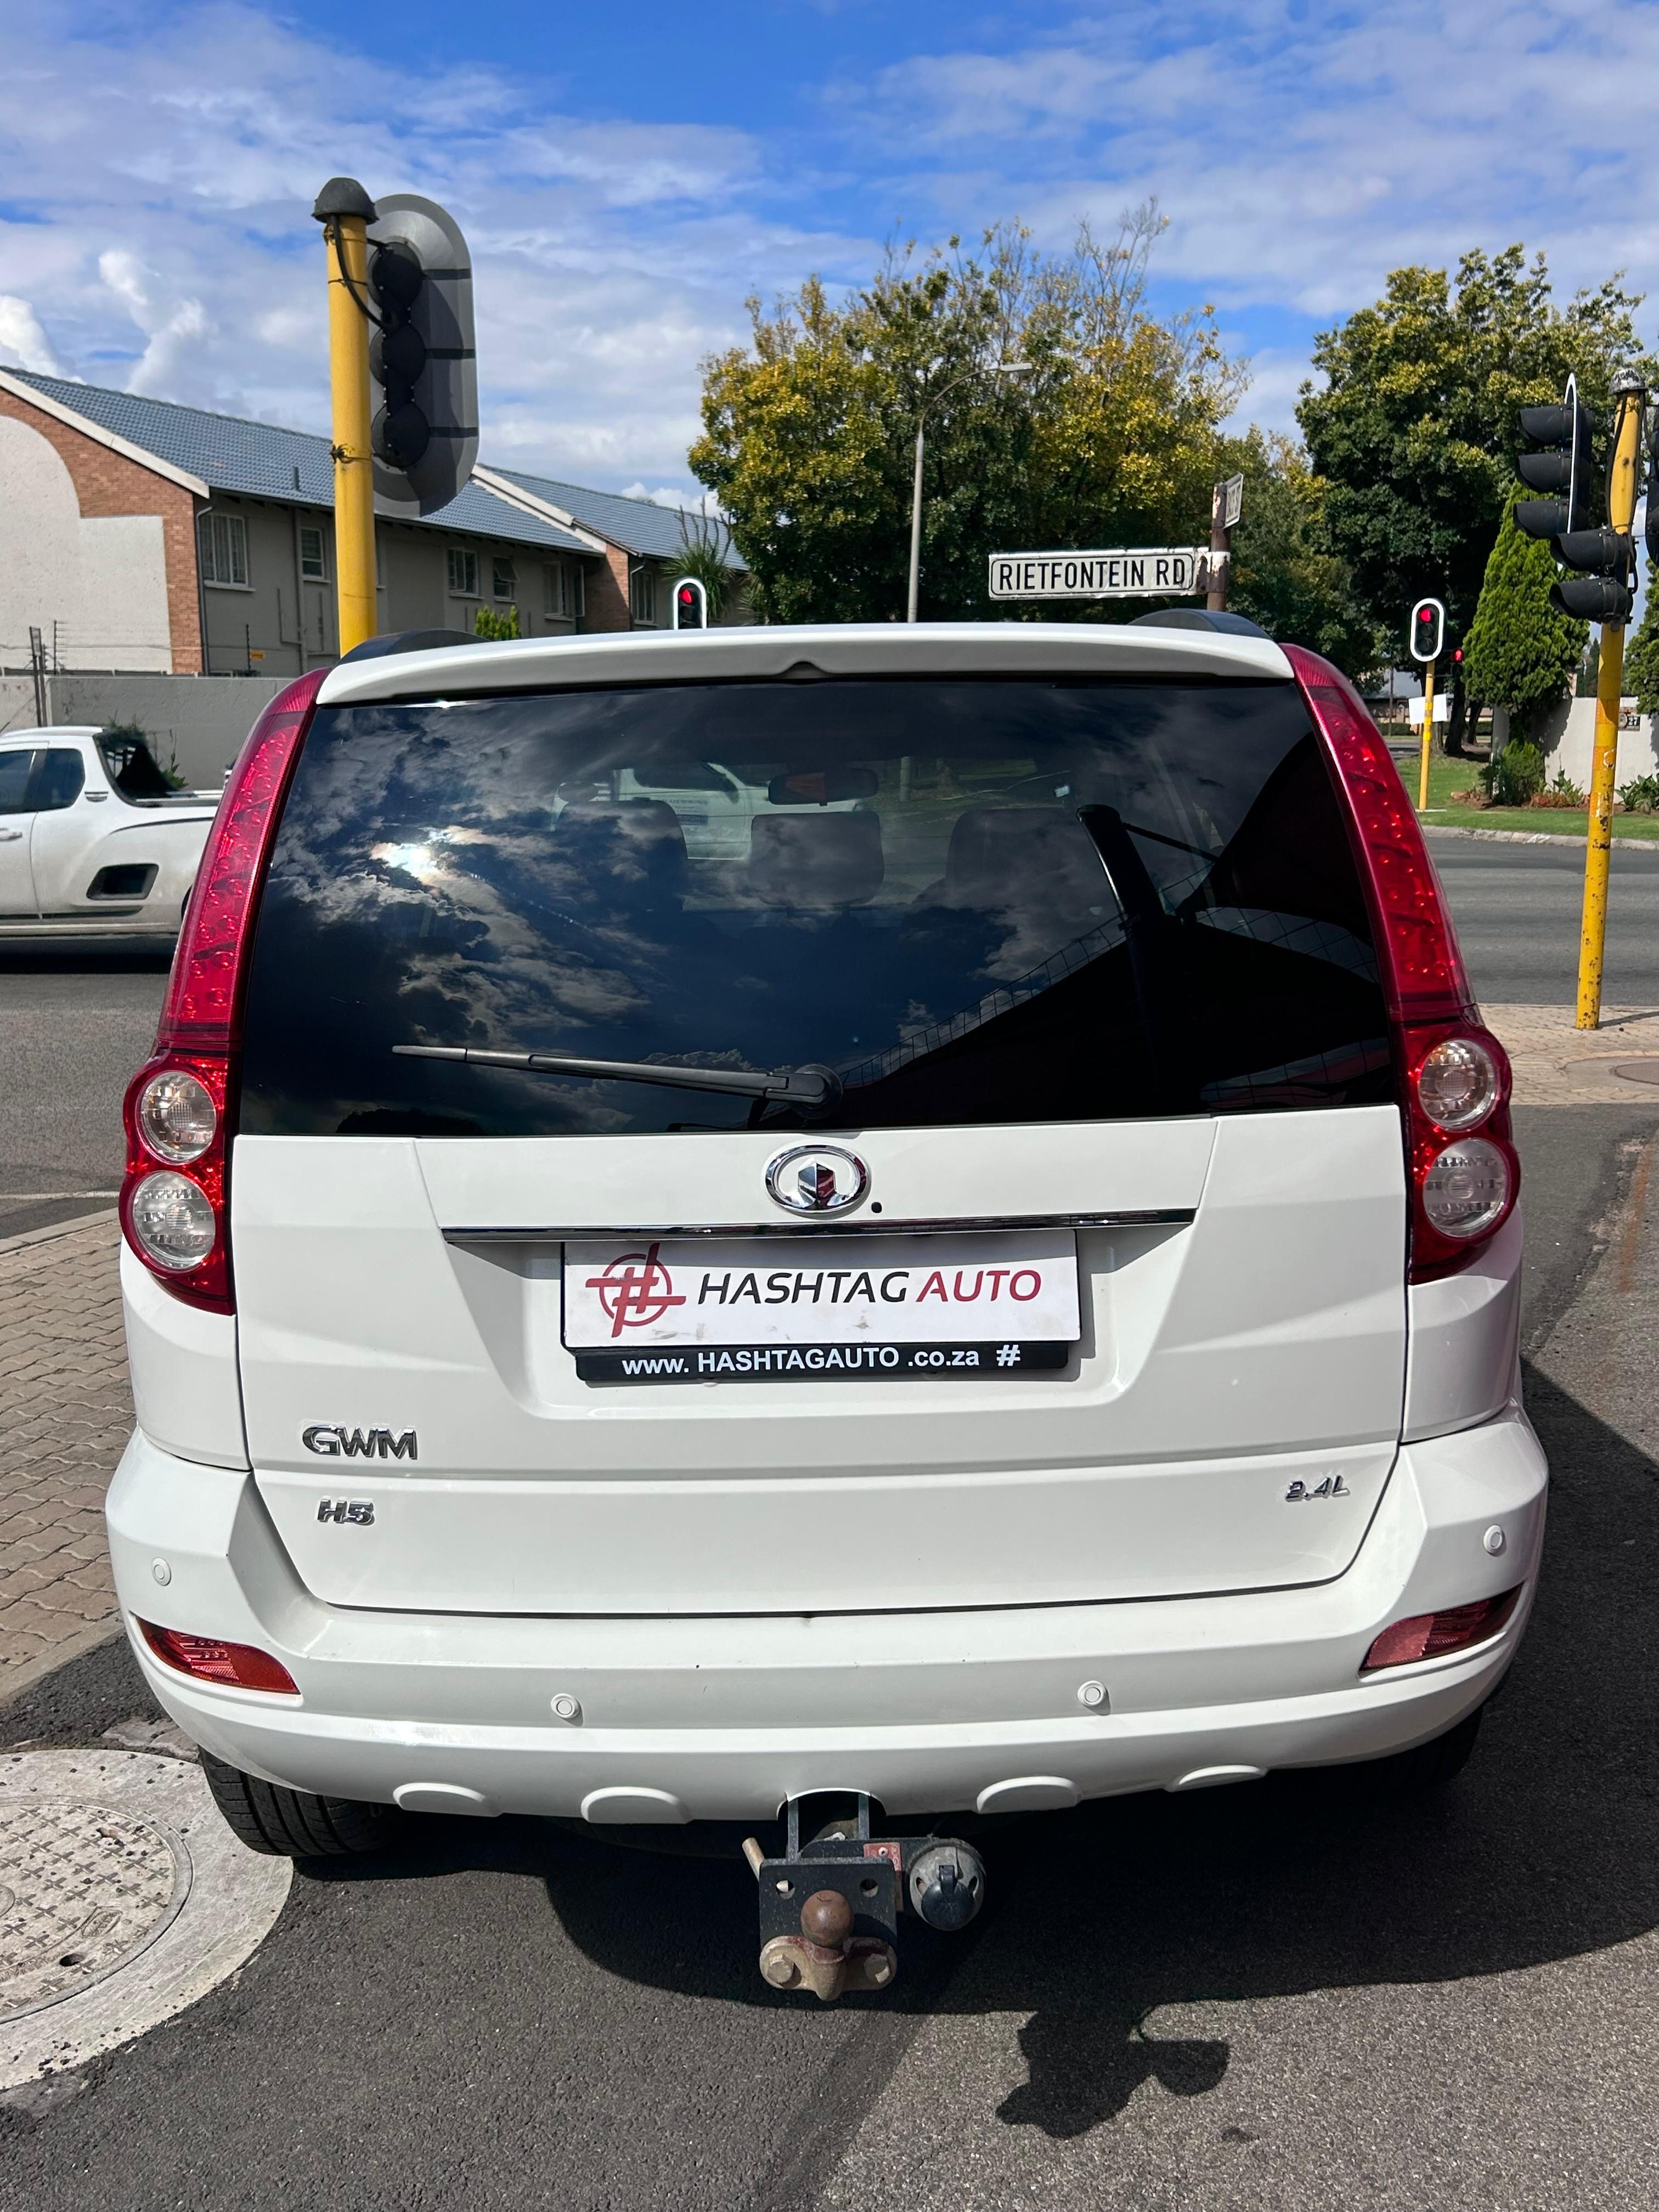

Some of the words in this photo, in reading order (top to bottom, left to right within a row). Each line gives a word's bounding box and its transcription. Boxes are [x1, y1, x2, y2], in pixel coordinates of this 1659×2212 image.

[999, 560, 1144, 590] RIETFONTEIN
[1156, 558, 1186, 585] RD
[698, 1272, 909, 1304] HASHTAG
[916, 1269, 1041, 1302] AUTO
[623, 1358, 689, 1375] www.
[698, 1348, 899, 1372] HASHTAGAUTO
[908, 1349, 979, 1367] .co.za
[302, 1425, 418, 1460] GWM
[1285, 1475, 1351, 1503] 2.4L
[317, 1499, 375, 1526] H5
